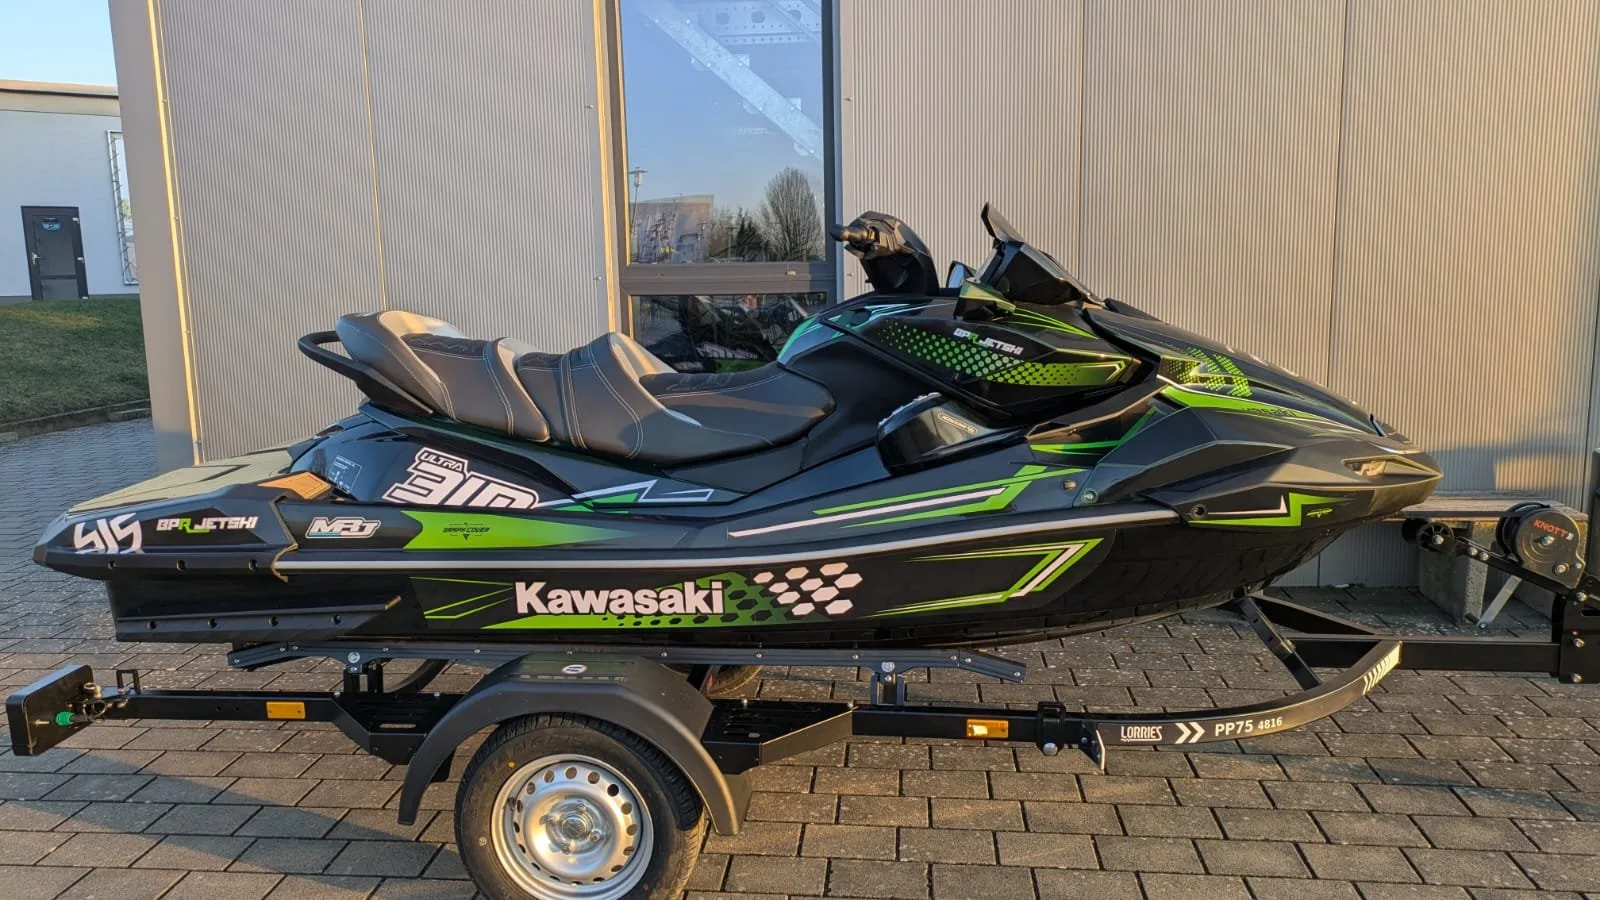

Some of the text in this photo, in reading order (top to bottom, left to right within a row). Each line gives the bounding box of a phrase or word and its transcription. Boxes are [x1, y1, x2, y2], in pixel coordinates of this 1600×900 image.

[419, 451, 465, 473] ULTRA
[383, 459, 540, 510] 310
[193, 515, 259, 531] JETSKI
[1533, 519, 1569, 538] KNOTT
[514, 580, 724, 615] Kawasaki
[1120, 725, 1163, 742] LORRIES
[1215, 716, 1283, 737] PP75 4816
